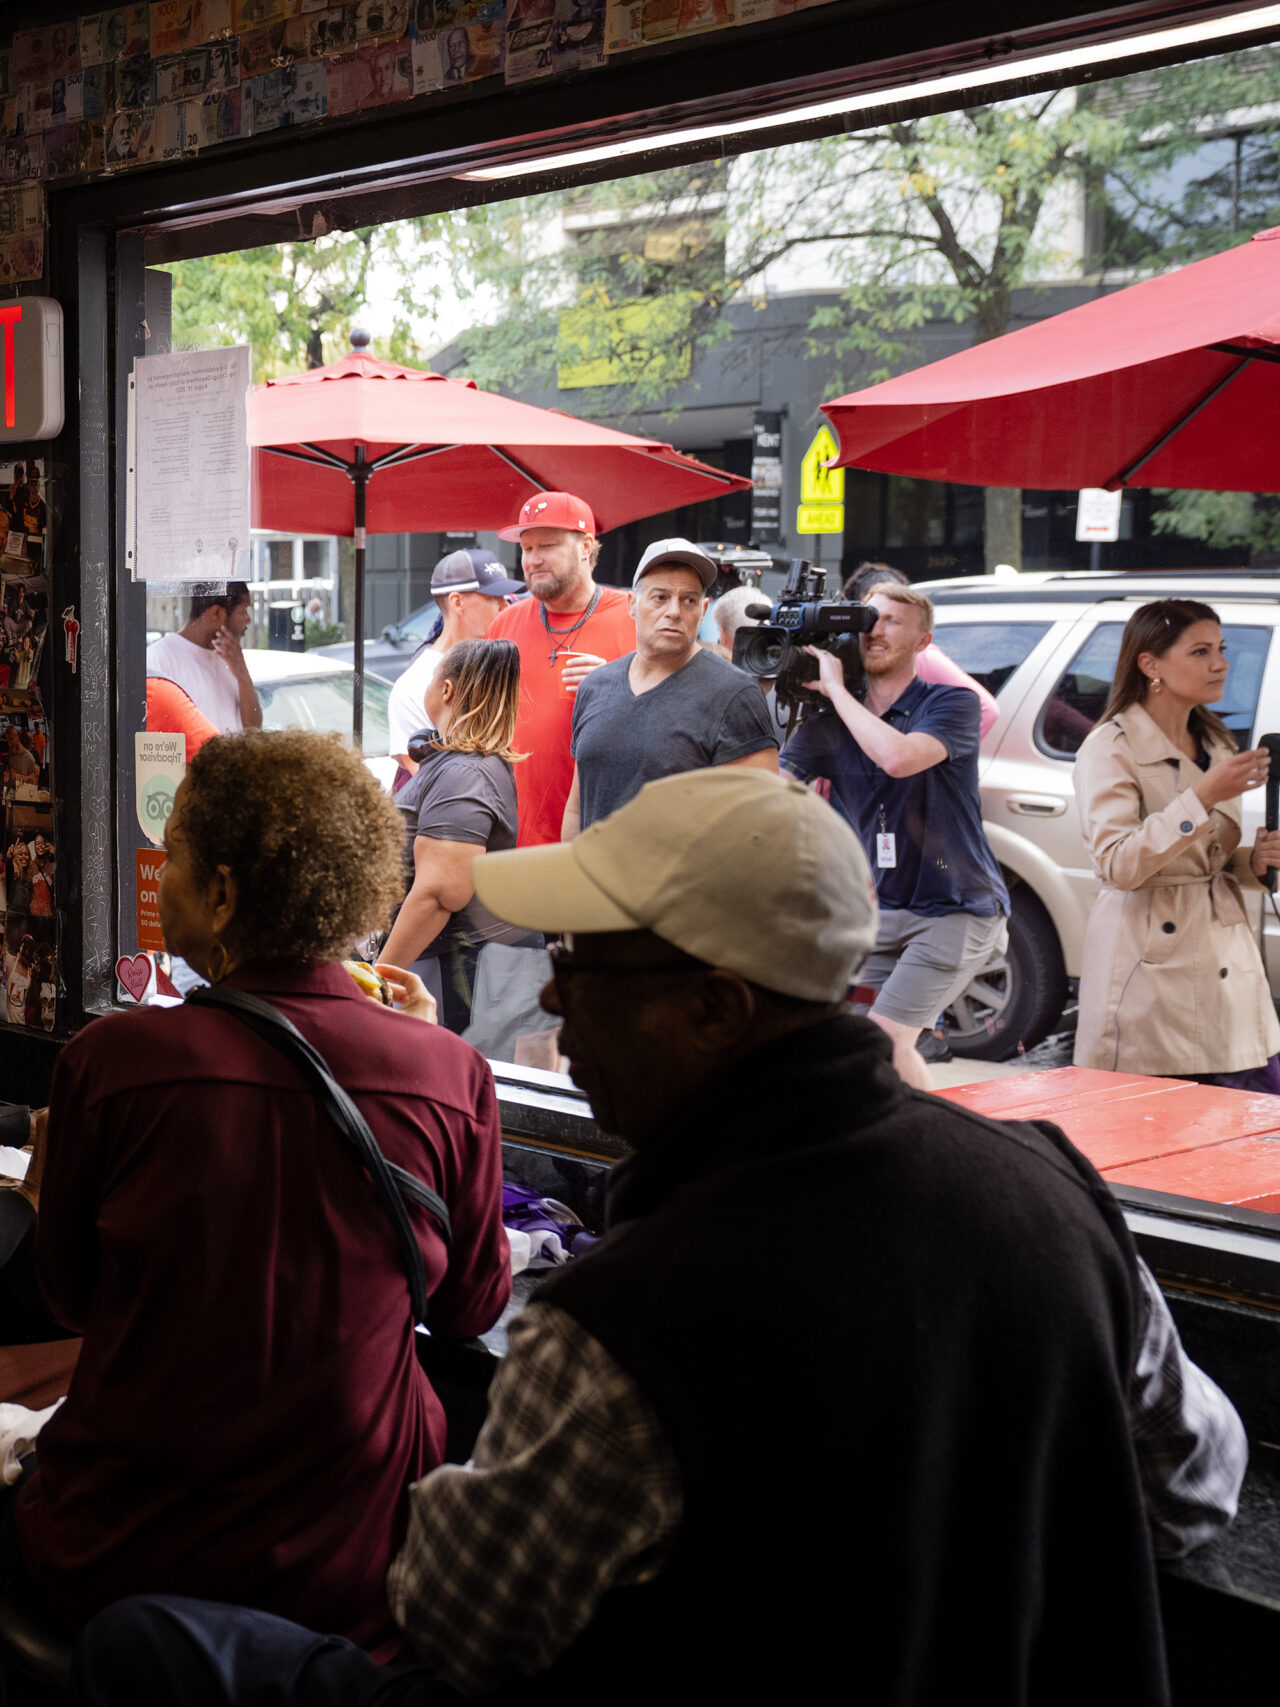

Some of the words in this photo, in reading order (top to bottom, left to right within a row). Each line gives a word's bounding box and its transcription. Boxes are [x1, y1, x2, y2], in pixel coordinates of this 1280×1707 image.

[183, 67, 200, 83] 20
[187, 133, 198, 147] 20
[140, 890, 158, 904] on
